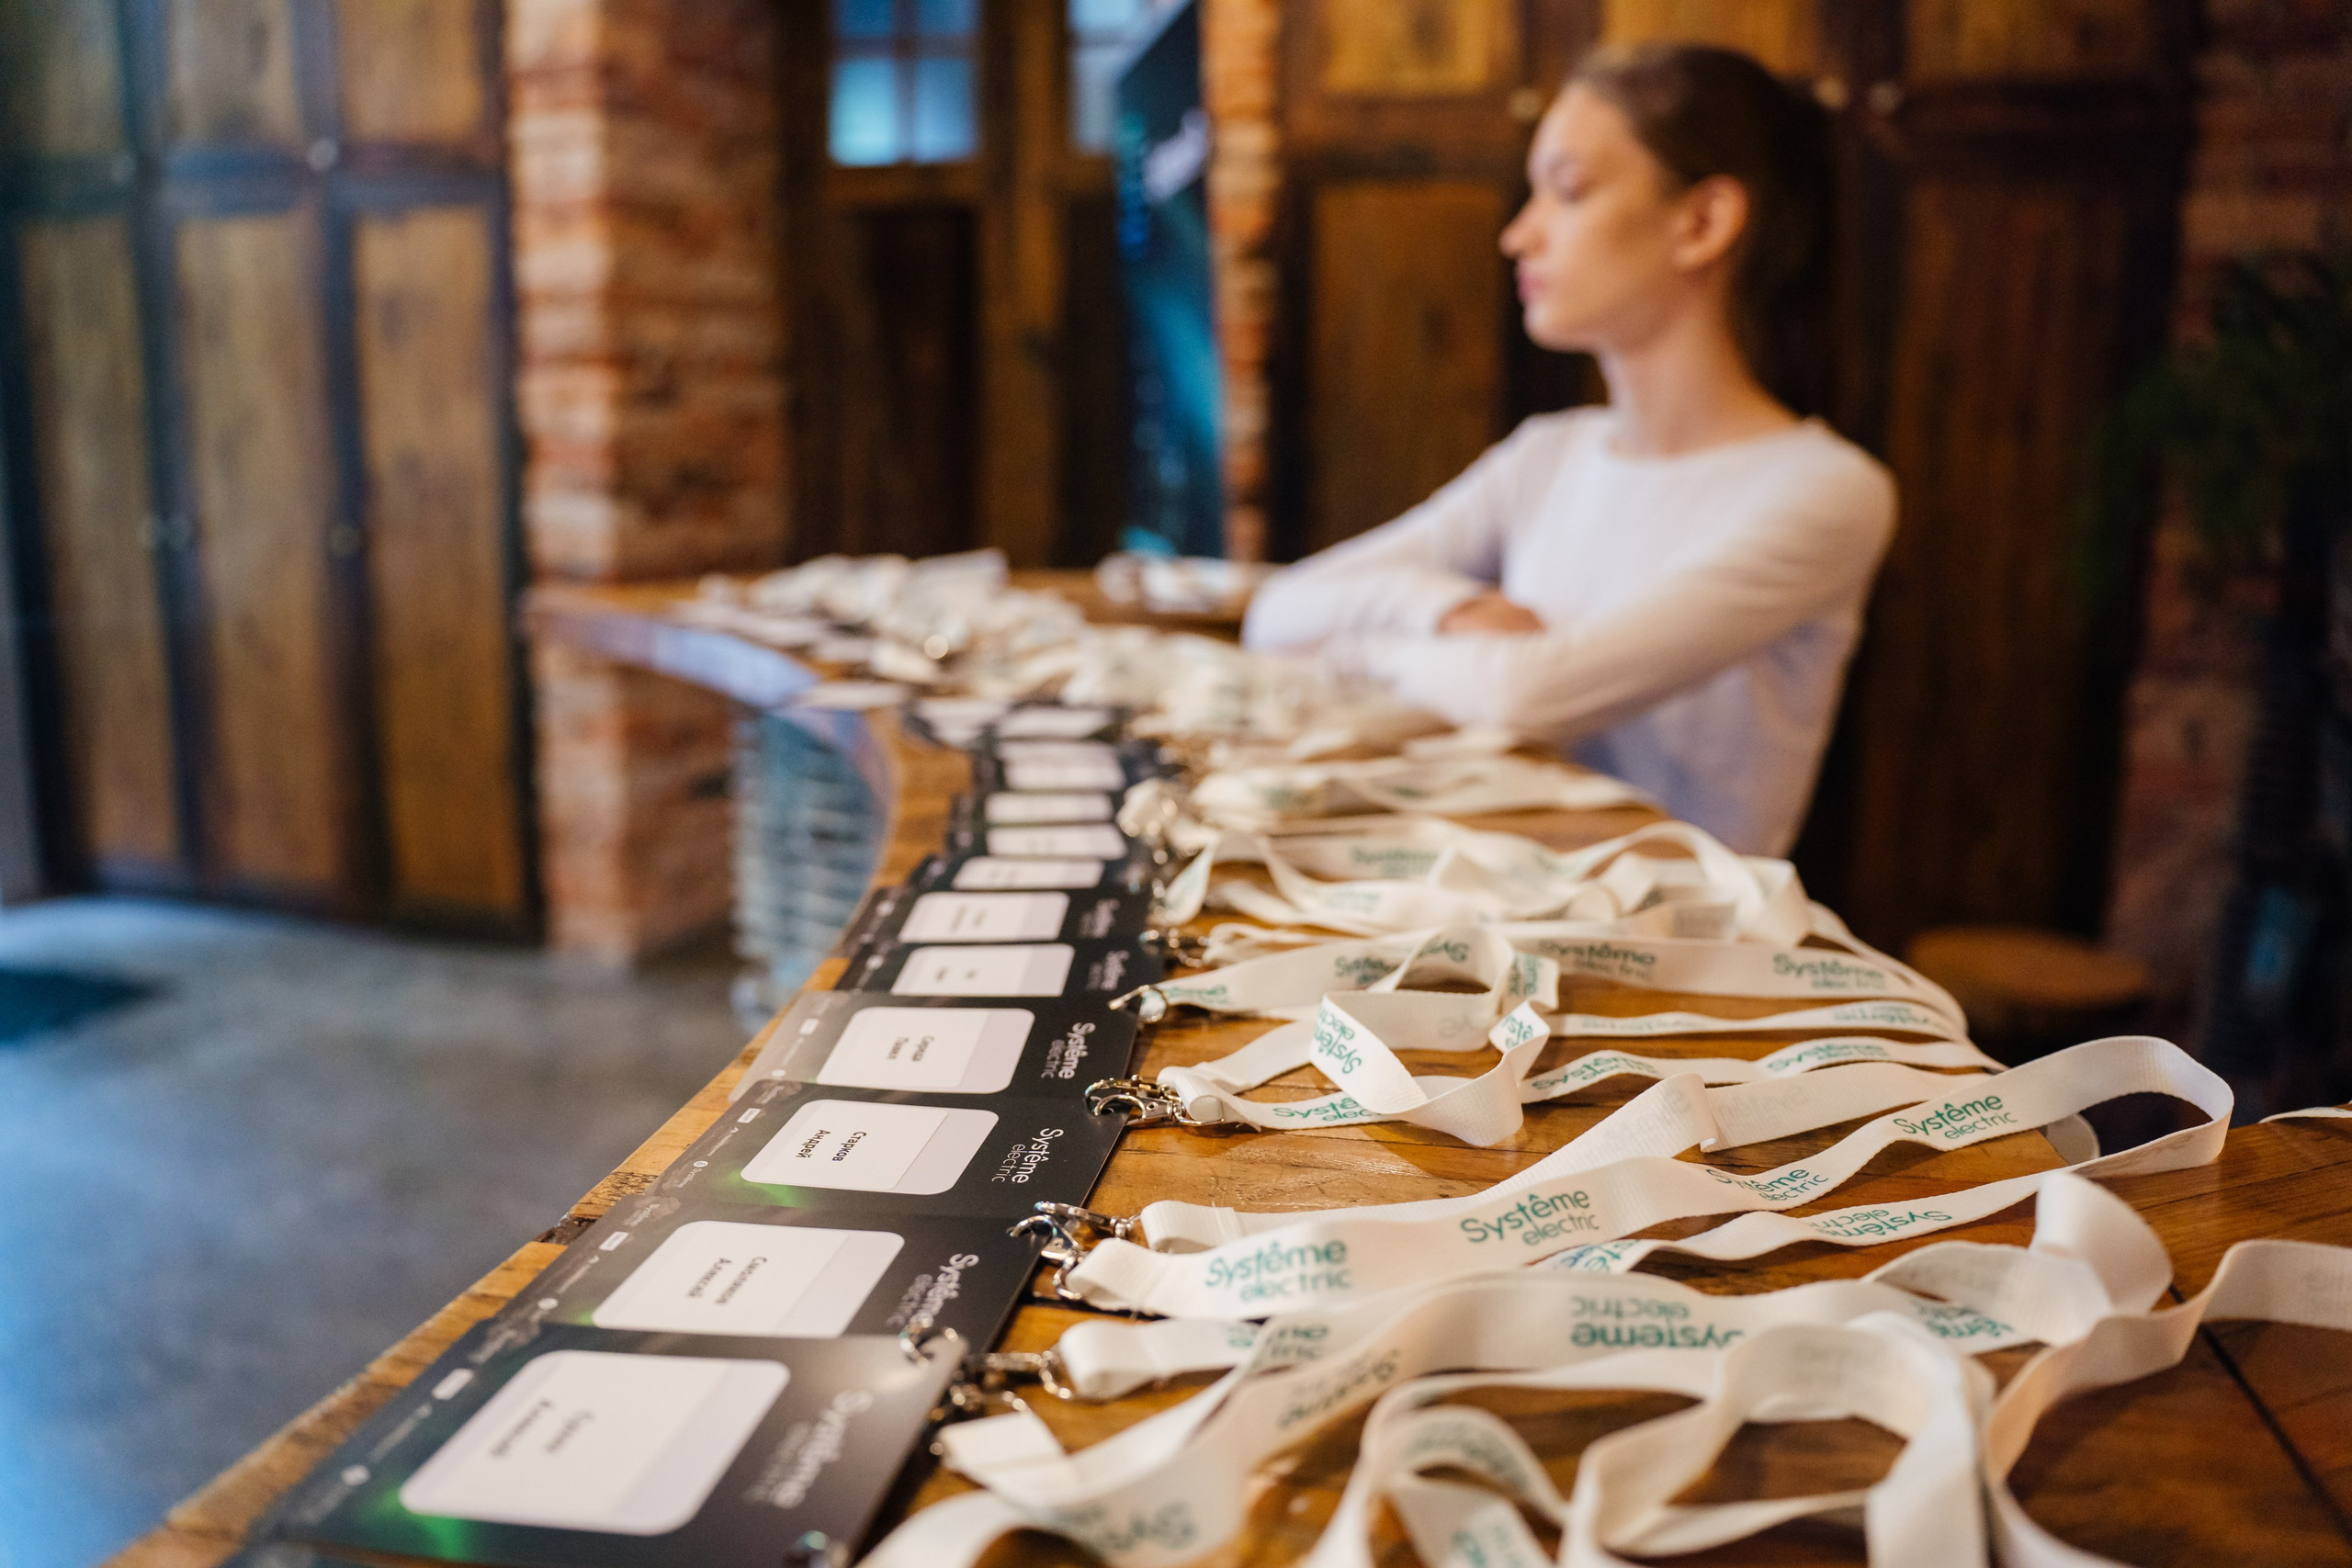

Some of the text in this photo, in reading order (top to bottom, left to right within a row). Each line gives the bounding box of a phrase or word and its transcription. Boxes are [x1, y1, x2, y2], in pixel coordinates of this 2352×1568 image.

[1893, 1095, 2004, 1135] Systême
[1944, 1111, 2018, 1139] electric
[796, 1129, 831, 1158] Андрей
[831, 1131, 867, 1162] Старков
[1012, 1128, 1064, 1184] Systême
[991, 1144, 1027, 1183] electric
[1460, 1190, 1590, 1243] Systême
[1521, 1213, 1600, 1246] electric
[1239, 1269, 1351, 1303] electric
